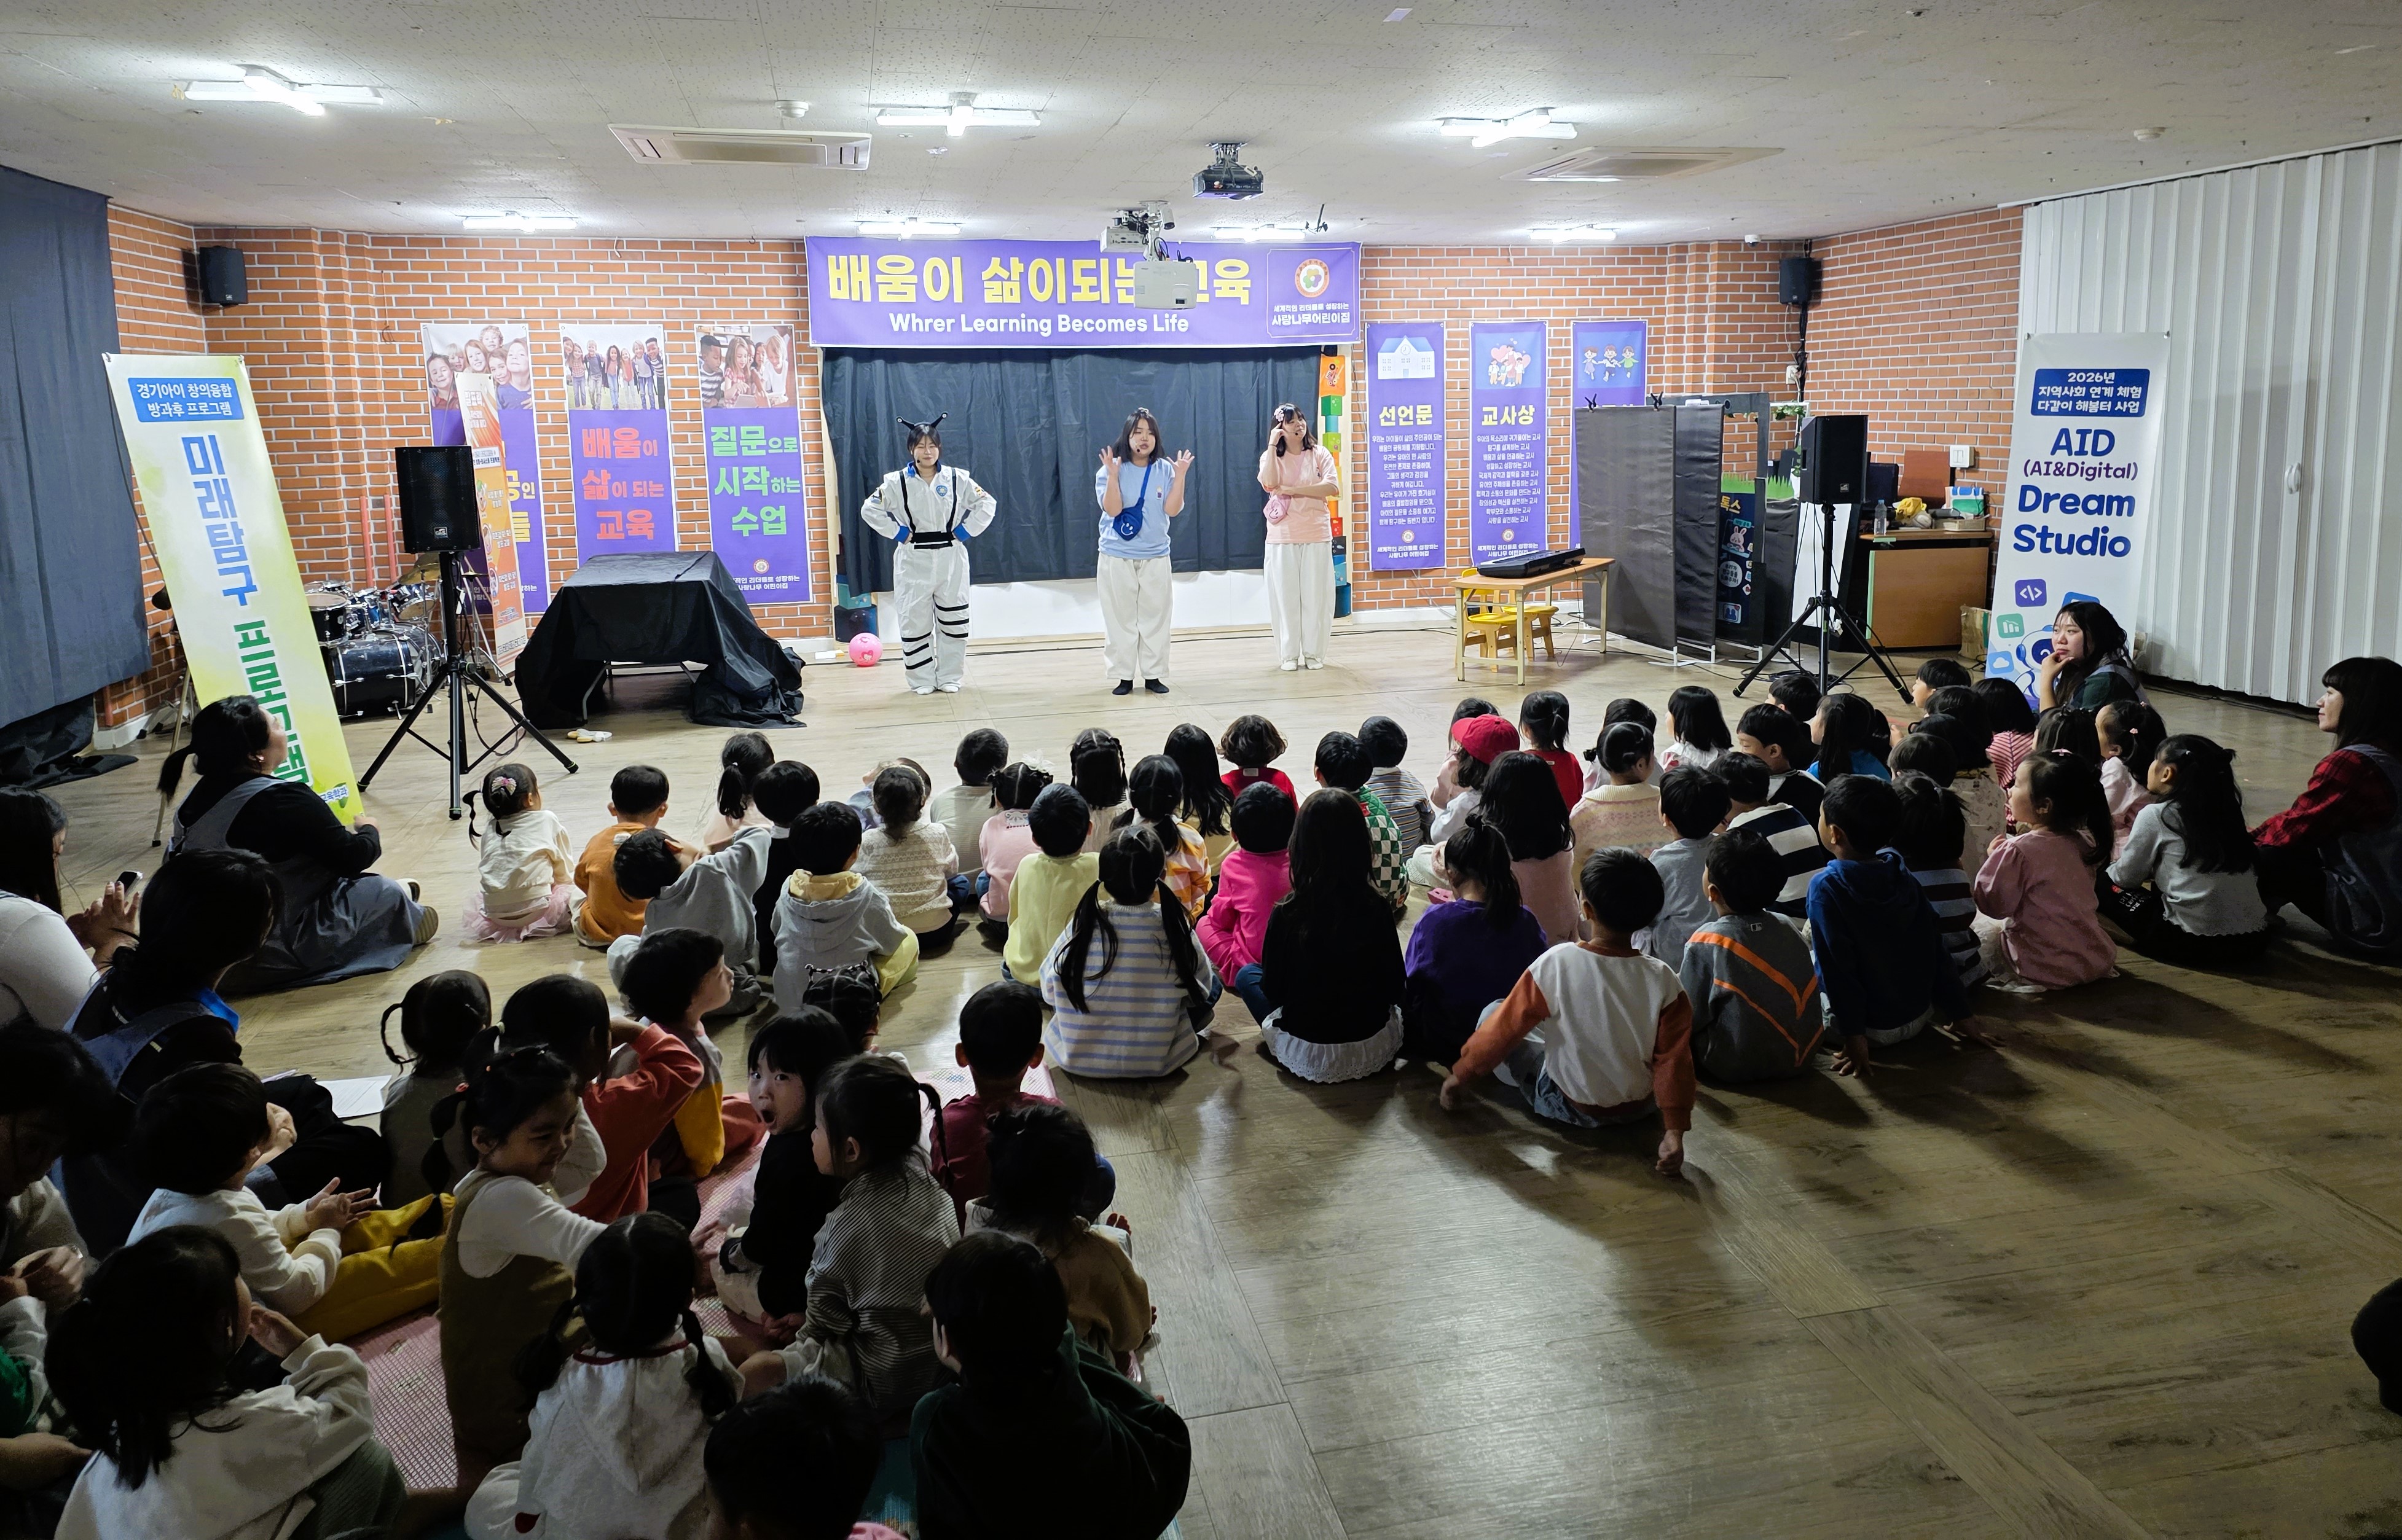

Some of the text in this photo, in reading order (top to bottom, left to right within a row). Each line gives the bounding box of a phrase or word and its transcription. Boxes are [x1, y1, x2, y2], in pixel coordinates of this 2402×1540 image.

[827, 254, 964, 303] 배움이
[890, 313, 1189, 337] Whrer Learning Becomes Life
[1271, 312, 1350, 326] 사랑나무어린이집
[136, 383, 233, 399] 경기아이 창의융합
[2068, 372, 2115, 384] 2026년
[2038, 386, 2142, 399] 지역사회 연계 체험
[147, 402, 233, 418] 방과후 프로그램
[1379, 404, 1433, 426] 선언문
[1482, 404, 1536, 426] 교사상
[2037, 401, 2140, 413] 다같이 해봄터 사업
[581, 427, 658, 458] 배움이
[710, 425, 798, 456] 질문으로
[2050, 428, 2116, 456] AID
[714, 466, 800, 497] 시작하는
[2023, 459, 2138, 481] (AI&Digital)
[582, 469, 664, 500] 삶이 되는
[2018, 485, 2136, 517] Dream
[181, 434, 258, 606] 미래탐구
[596, 509, 654, 541] 교육
[732, 505, 787, 537] 수업
[2013, 524, 2131, 558] Studio
